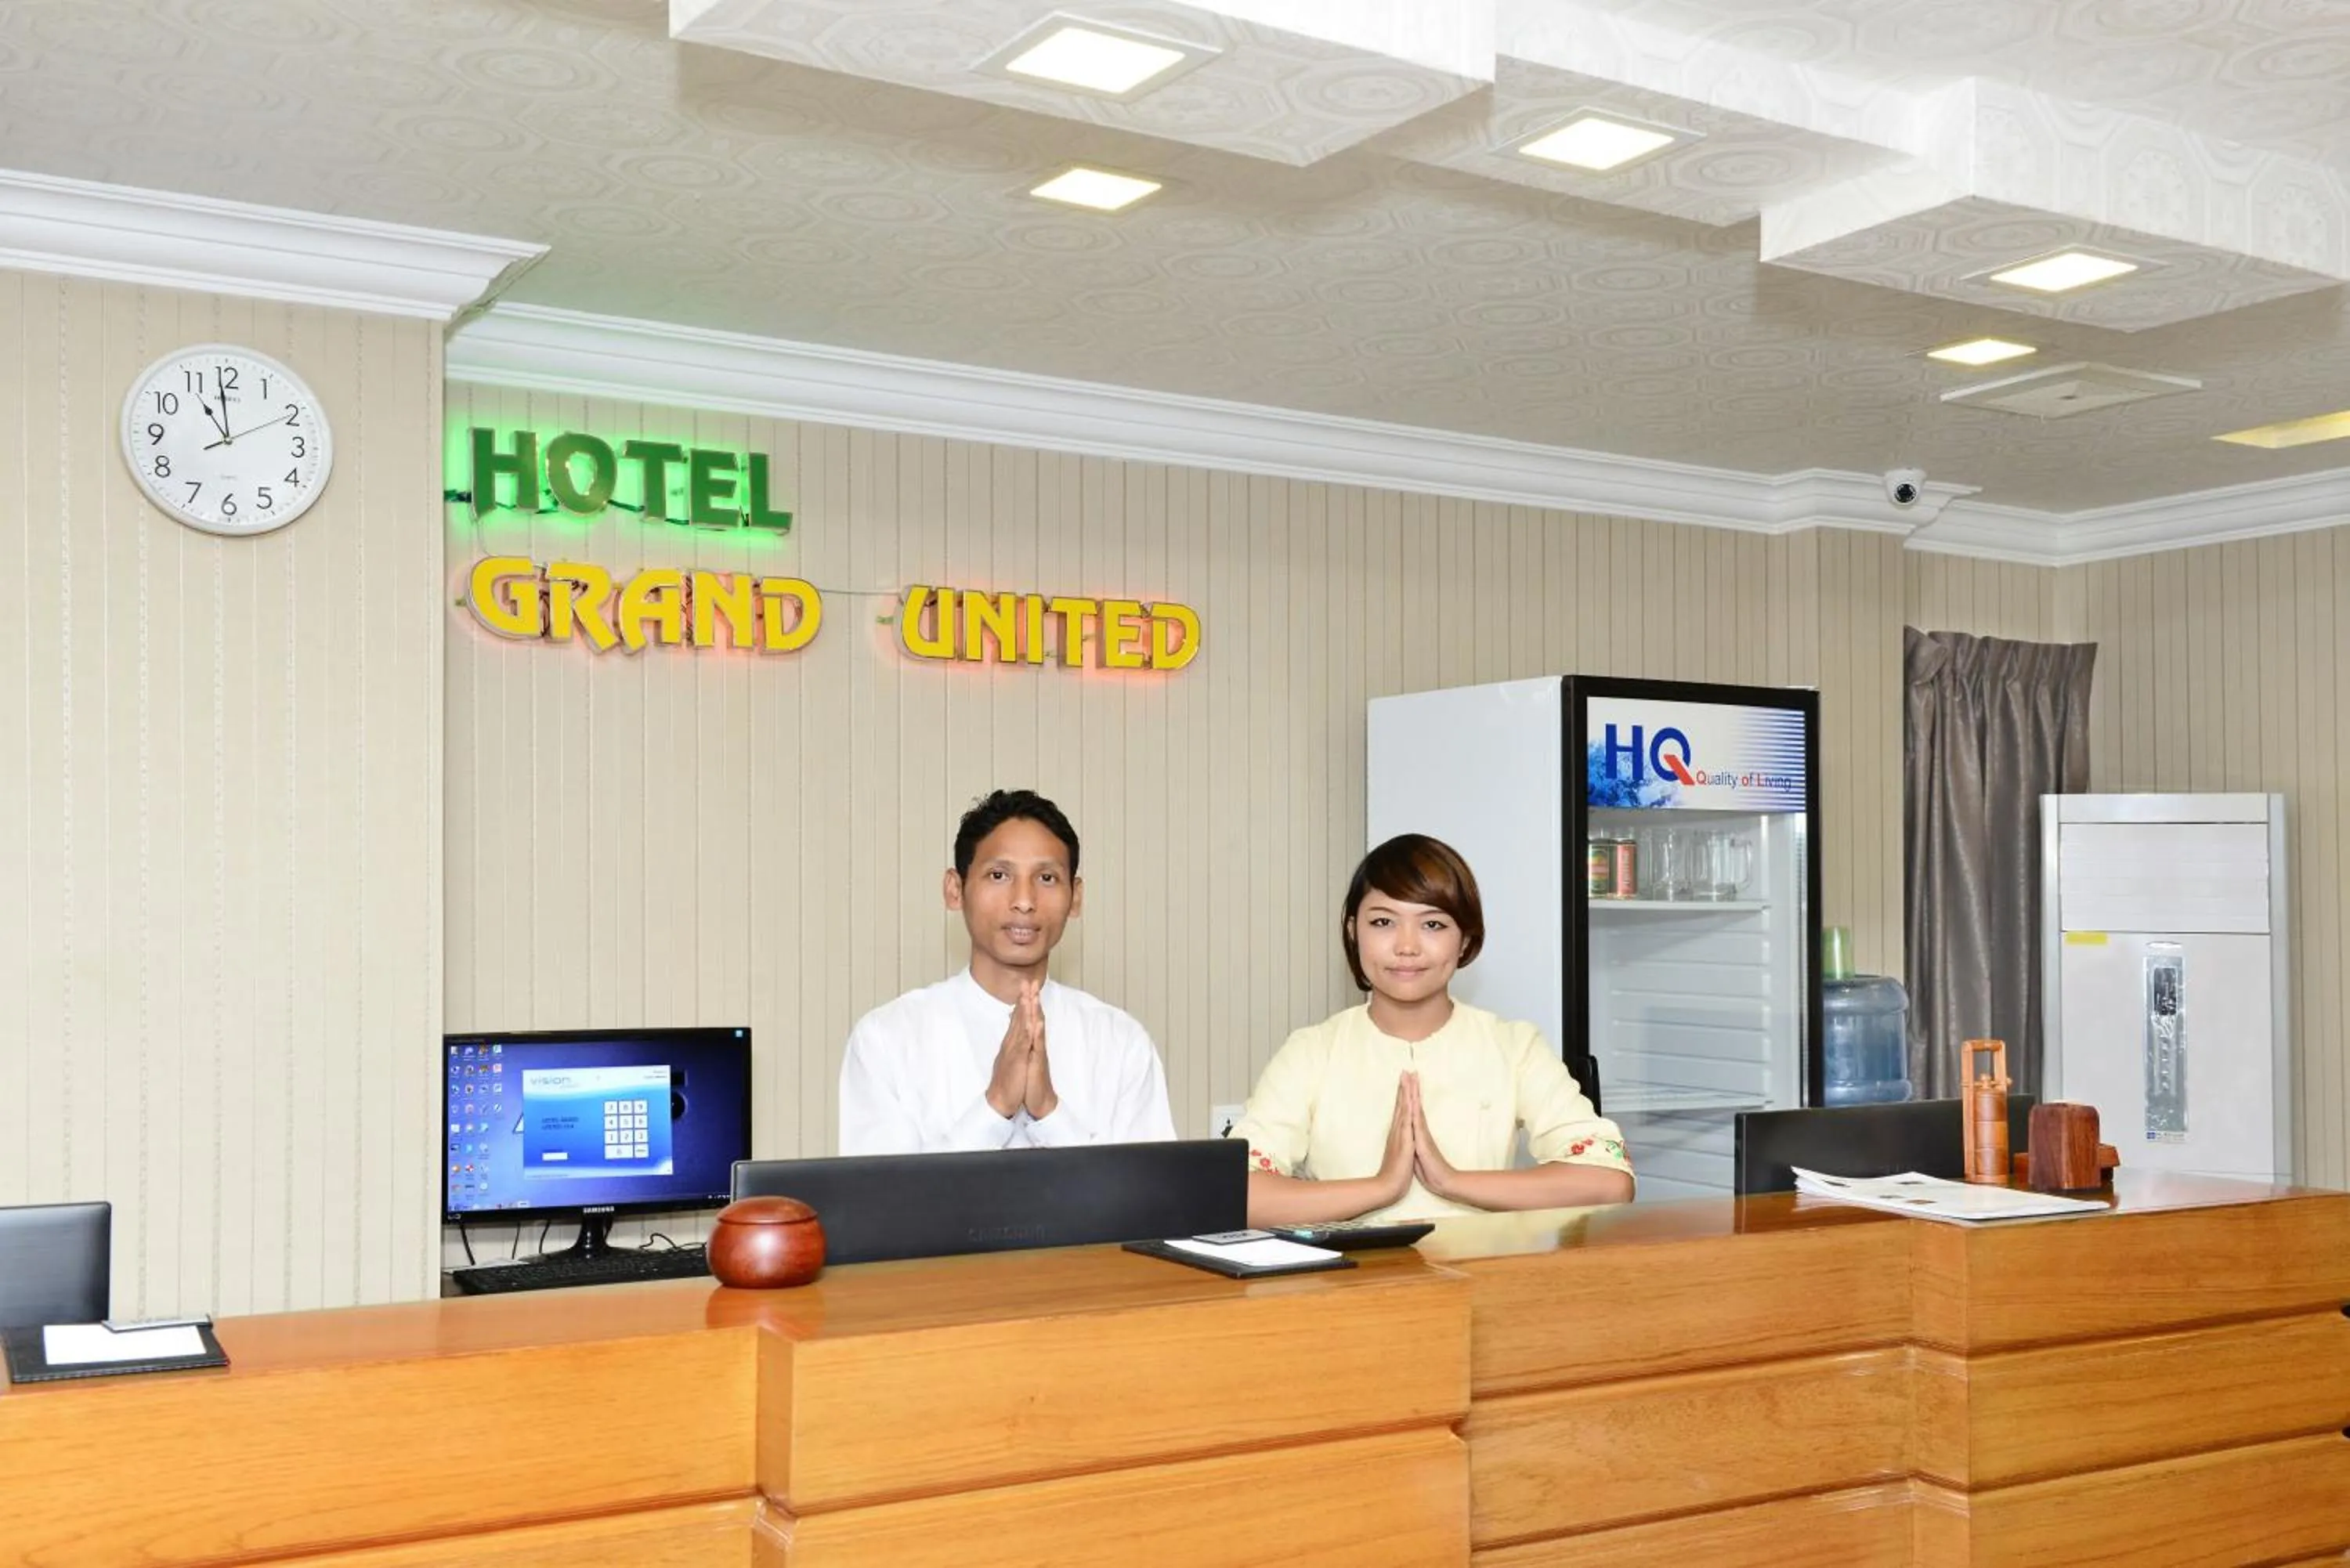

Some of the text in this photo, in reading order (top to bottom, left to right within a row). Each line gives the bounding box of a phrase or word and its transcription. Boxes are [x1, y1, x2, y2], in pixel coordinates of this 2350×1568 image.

[185, 370, 203, 393] 11
[215, 366, 239, 389] 12
[261, 378, 268, 399] 1
[154, 392, 179, 415] 10
[284, 403, 300, 427] 2
[147, 423, 164, 446] 9
[291, 436, 306, 458] 3
[154, 455, 172, 478] 8
[284, 468, 300, 487] 4
[472, 427, 794, 535] HOTEL
[185, 482, 202, 504] 7
[221, 493, 237, 515] 6
[256, 486, 273, 509] 5
[470, 555, 1201, 670] GRAND UNITED
[1605, 723, 1696, 786] HQ
[1696, 770, 1792, 793] Quality of Living
